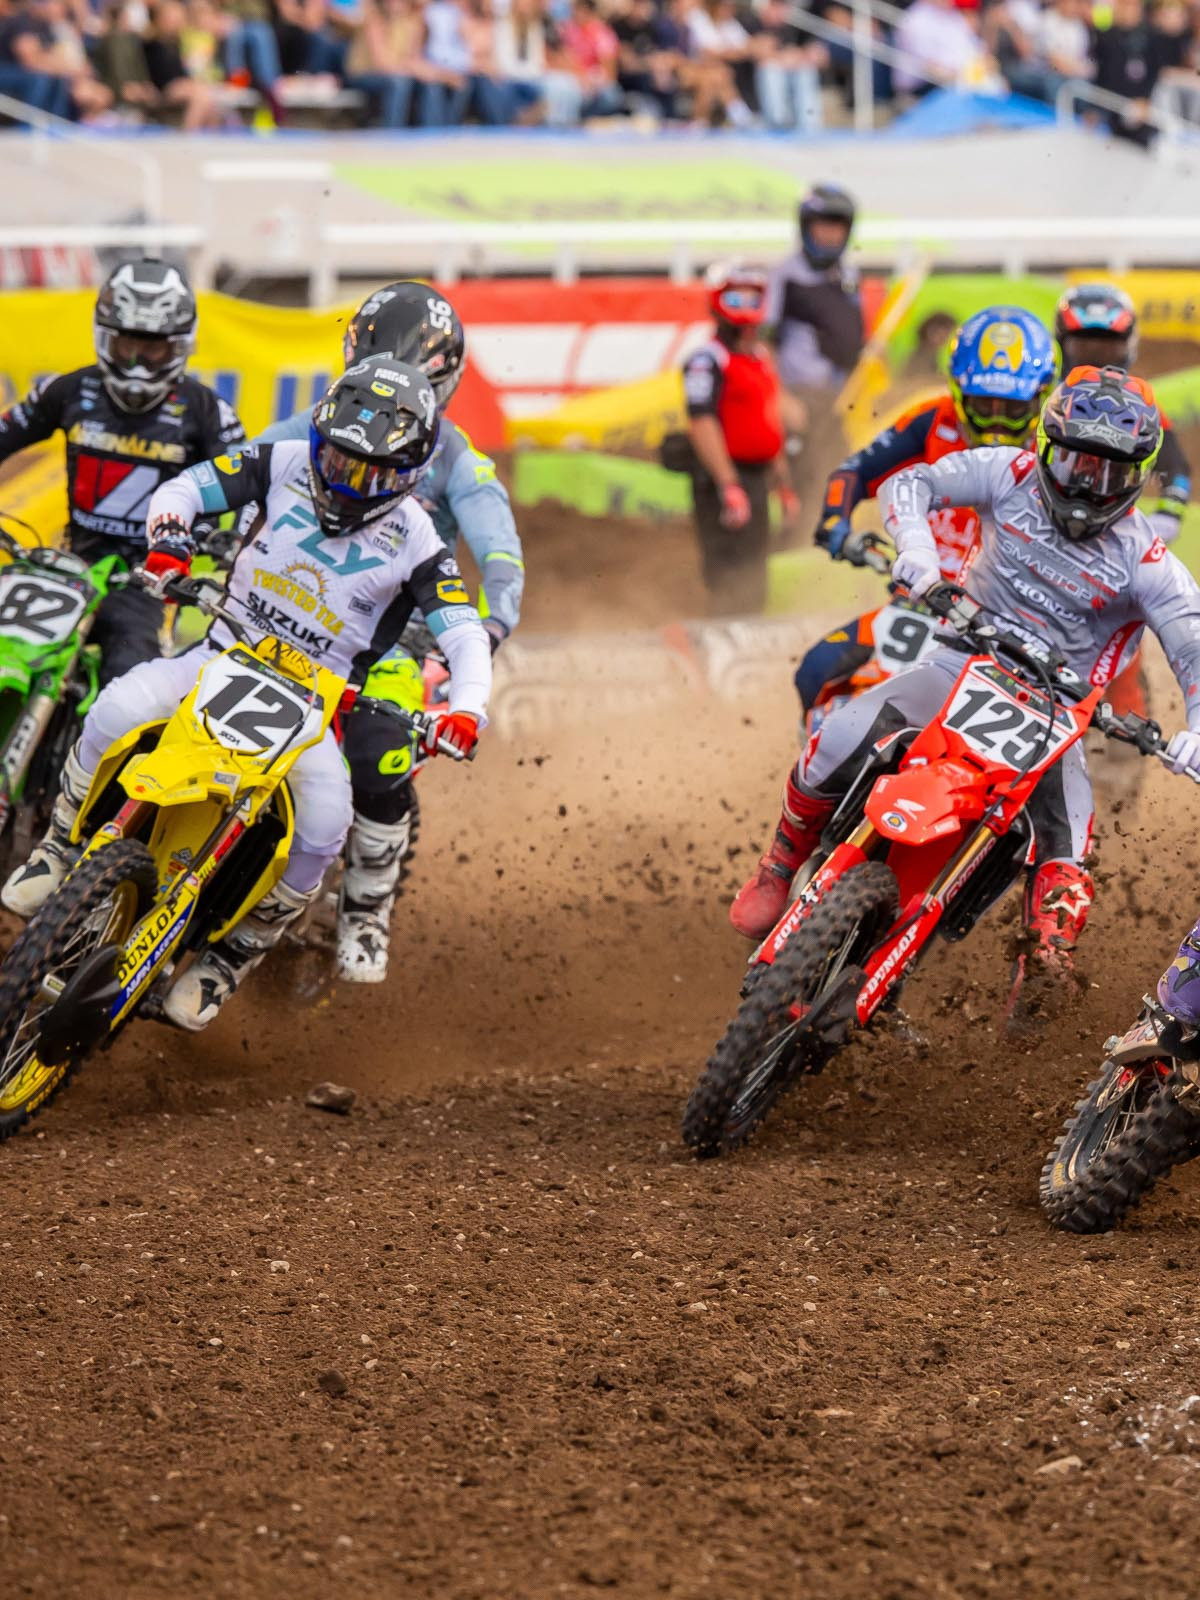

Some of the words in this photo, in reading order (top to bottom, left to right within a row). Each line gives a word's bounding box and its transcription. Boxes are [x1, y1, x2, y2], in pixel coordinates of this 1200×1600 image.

[271, 504, 387, 577] FLY
[247, 591, 334, 651] SUZUKI
[253, 568, 318, 613] TWISTED
[314, 600, 346, 637] TEA
[1013, 577, 1088, 626] HONDA
[199, 674, 304, 749] 12
[946, 689, 1064, 772] 125
[118, 894, 183, 981] DUNLOP
[866, 924, 918, 992] DUNLOP
